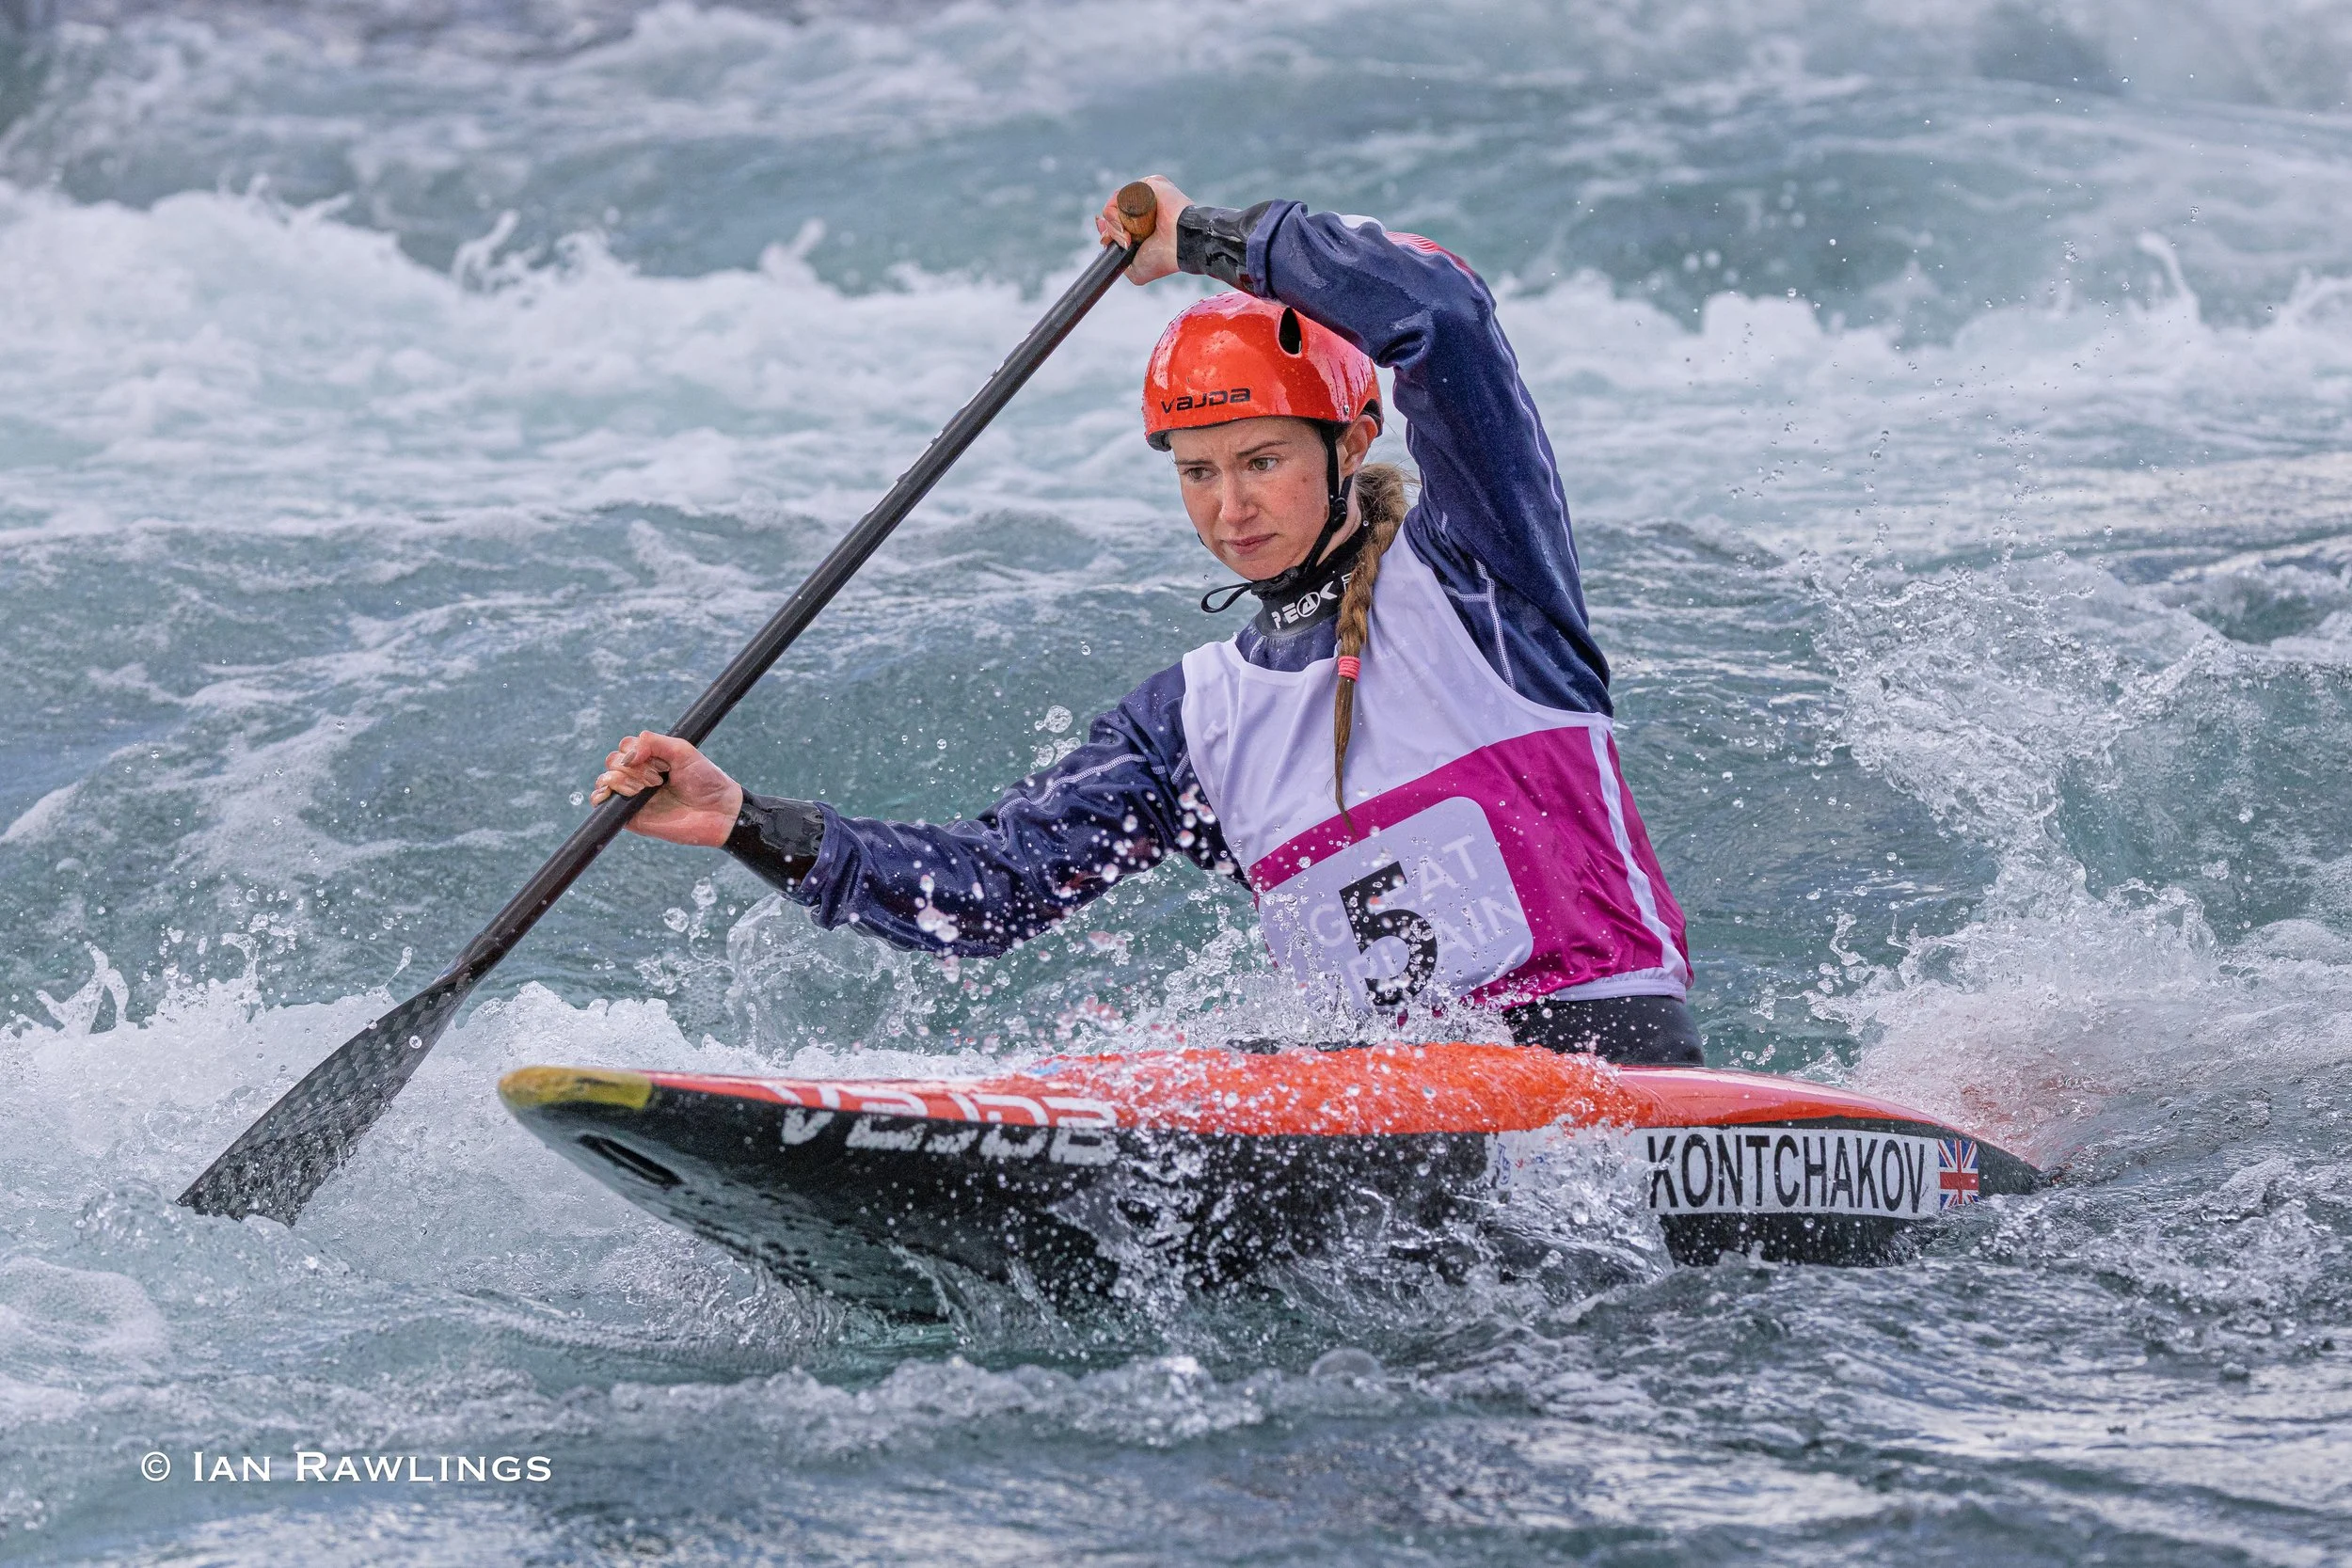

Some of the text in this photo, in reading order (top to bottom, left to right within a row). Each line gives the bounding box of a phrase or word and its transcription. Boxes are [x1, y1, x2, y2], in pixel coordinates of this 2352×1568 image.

[1271, 580, 1338, 629] PEAK
[1339, 860, 1438, 1006] 5
[1647, 1133, 1926, 1213] KONTCHAKOV
